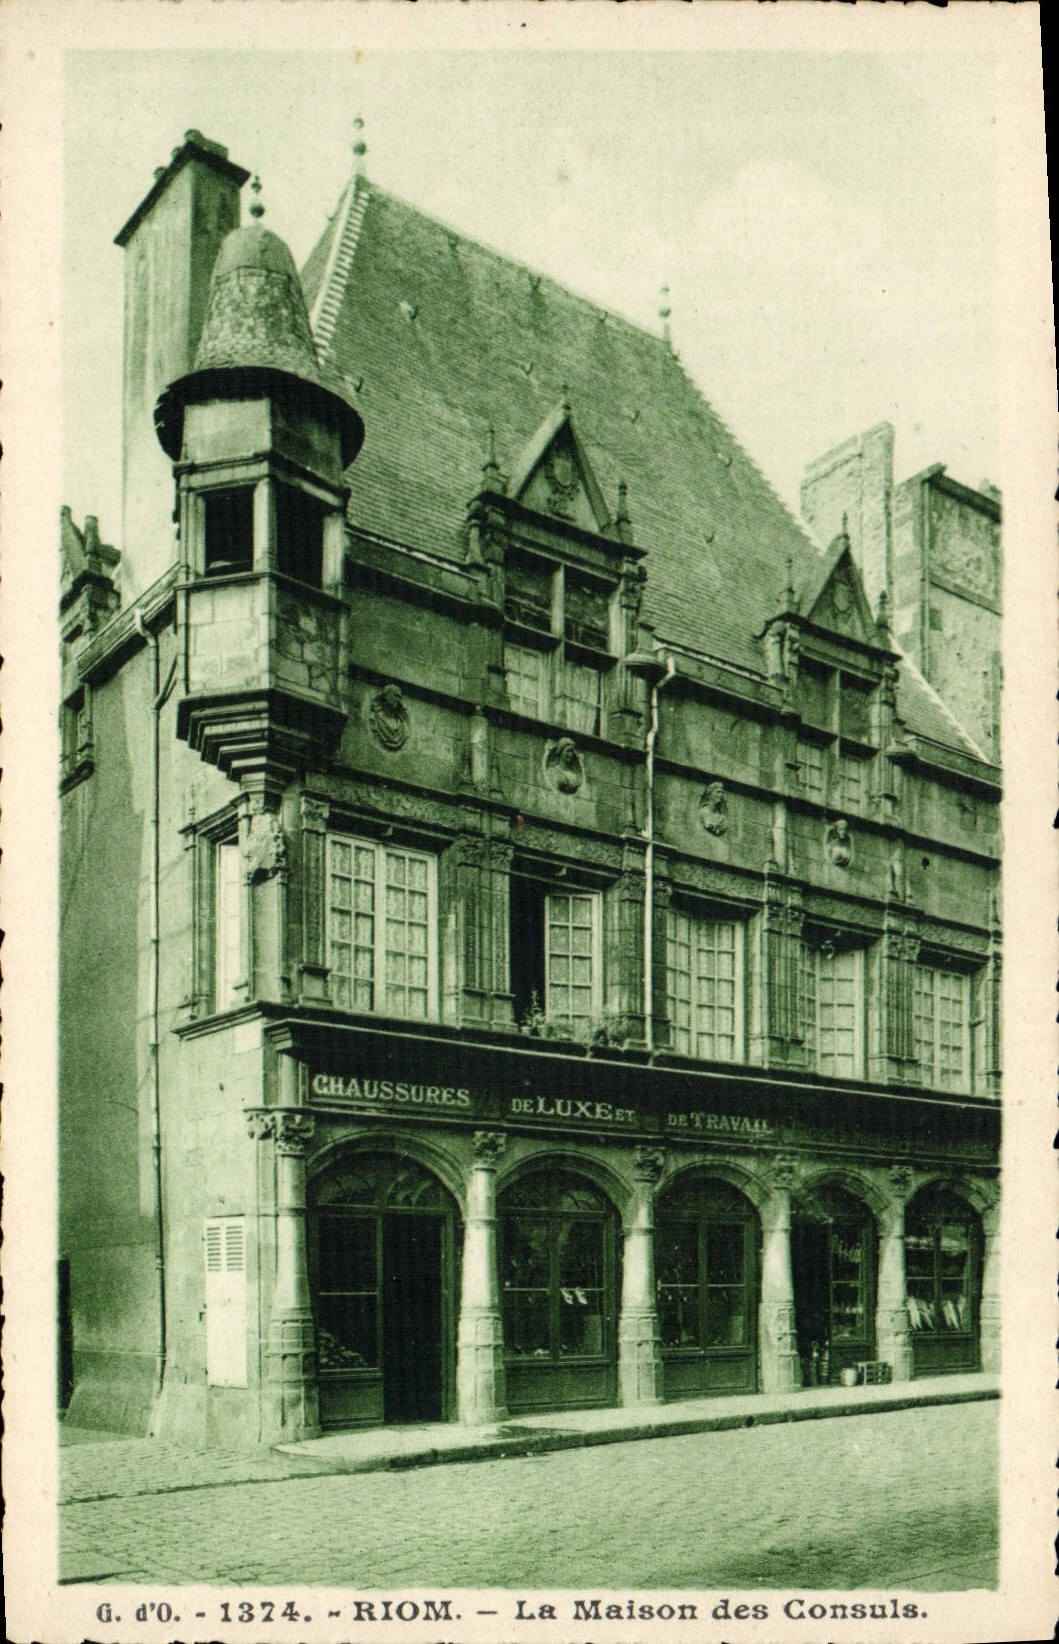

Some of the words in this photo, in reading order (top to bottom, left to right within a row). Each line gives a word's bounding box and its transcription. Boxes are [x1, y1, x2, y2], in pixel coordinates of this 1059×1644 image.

[312, 1074, 470, 1106] CHAUSSURES
[511, 1098, 534, 1113] DE
[536, 1096, 613, 1120] LUXE
[615, 1108, 635, 1122] ET
[667, 1113, 688, 1127] DE
[690, 1111, 773, 1135] TRAVAIL
